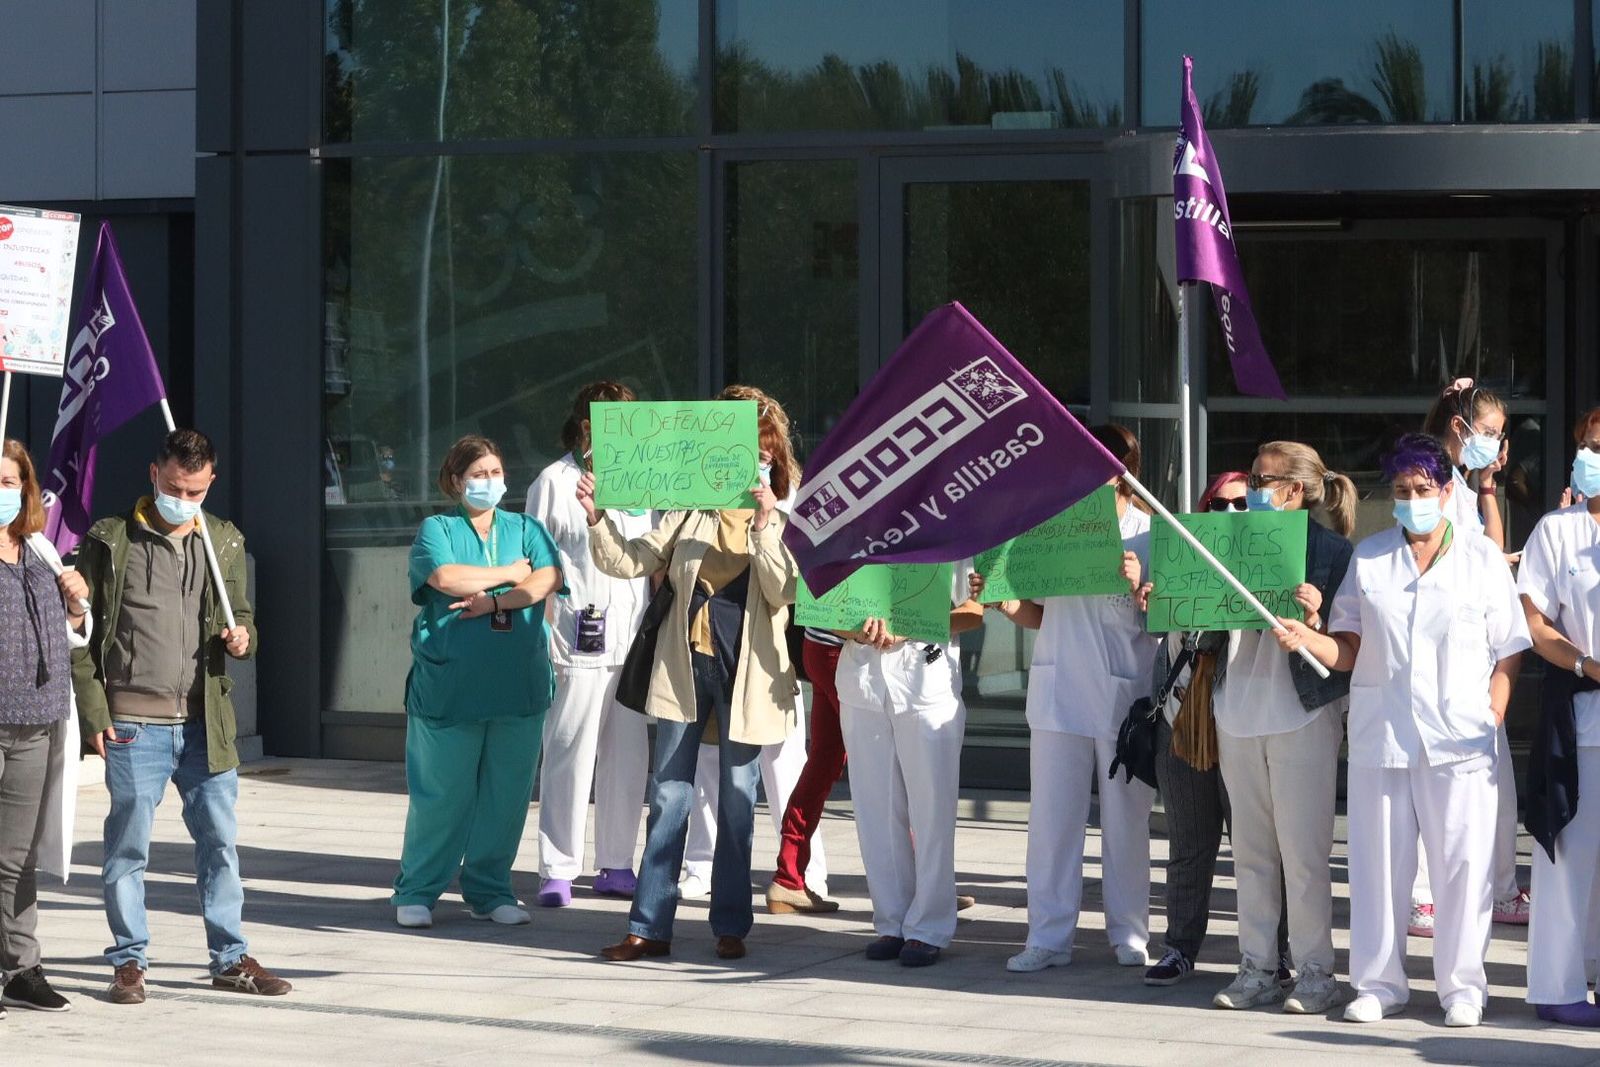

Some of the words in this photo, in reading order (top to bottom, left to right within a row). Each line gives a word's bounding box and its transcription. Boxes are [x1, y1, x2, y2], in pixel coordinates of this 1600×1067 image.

[1174, 196, 1231, 241] stilla
[603, 407, 640, 437] EN
[600, 443, 625, 468] DE
[628, 440, 706, 467] NUESTRAS
[1157, 596, 1215, 628] TCE
